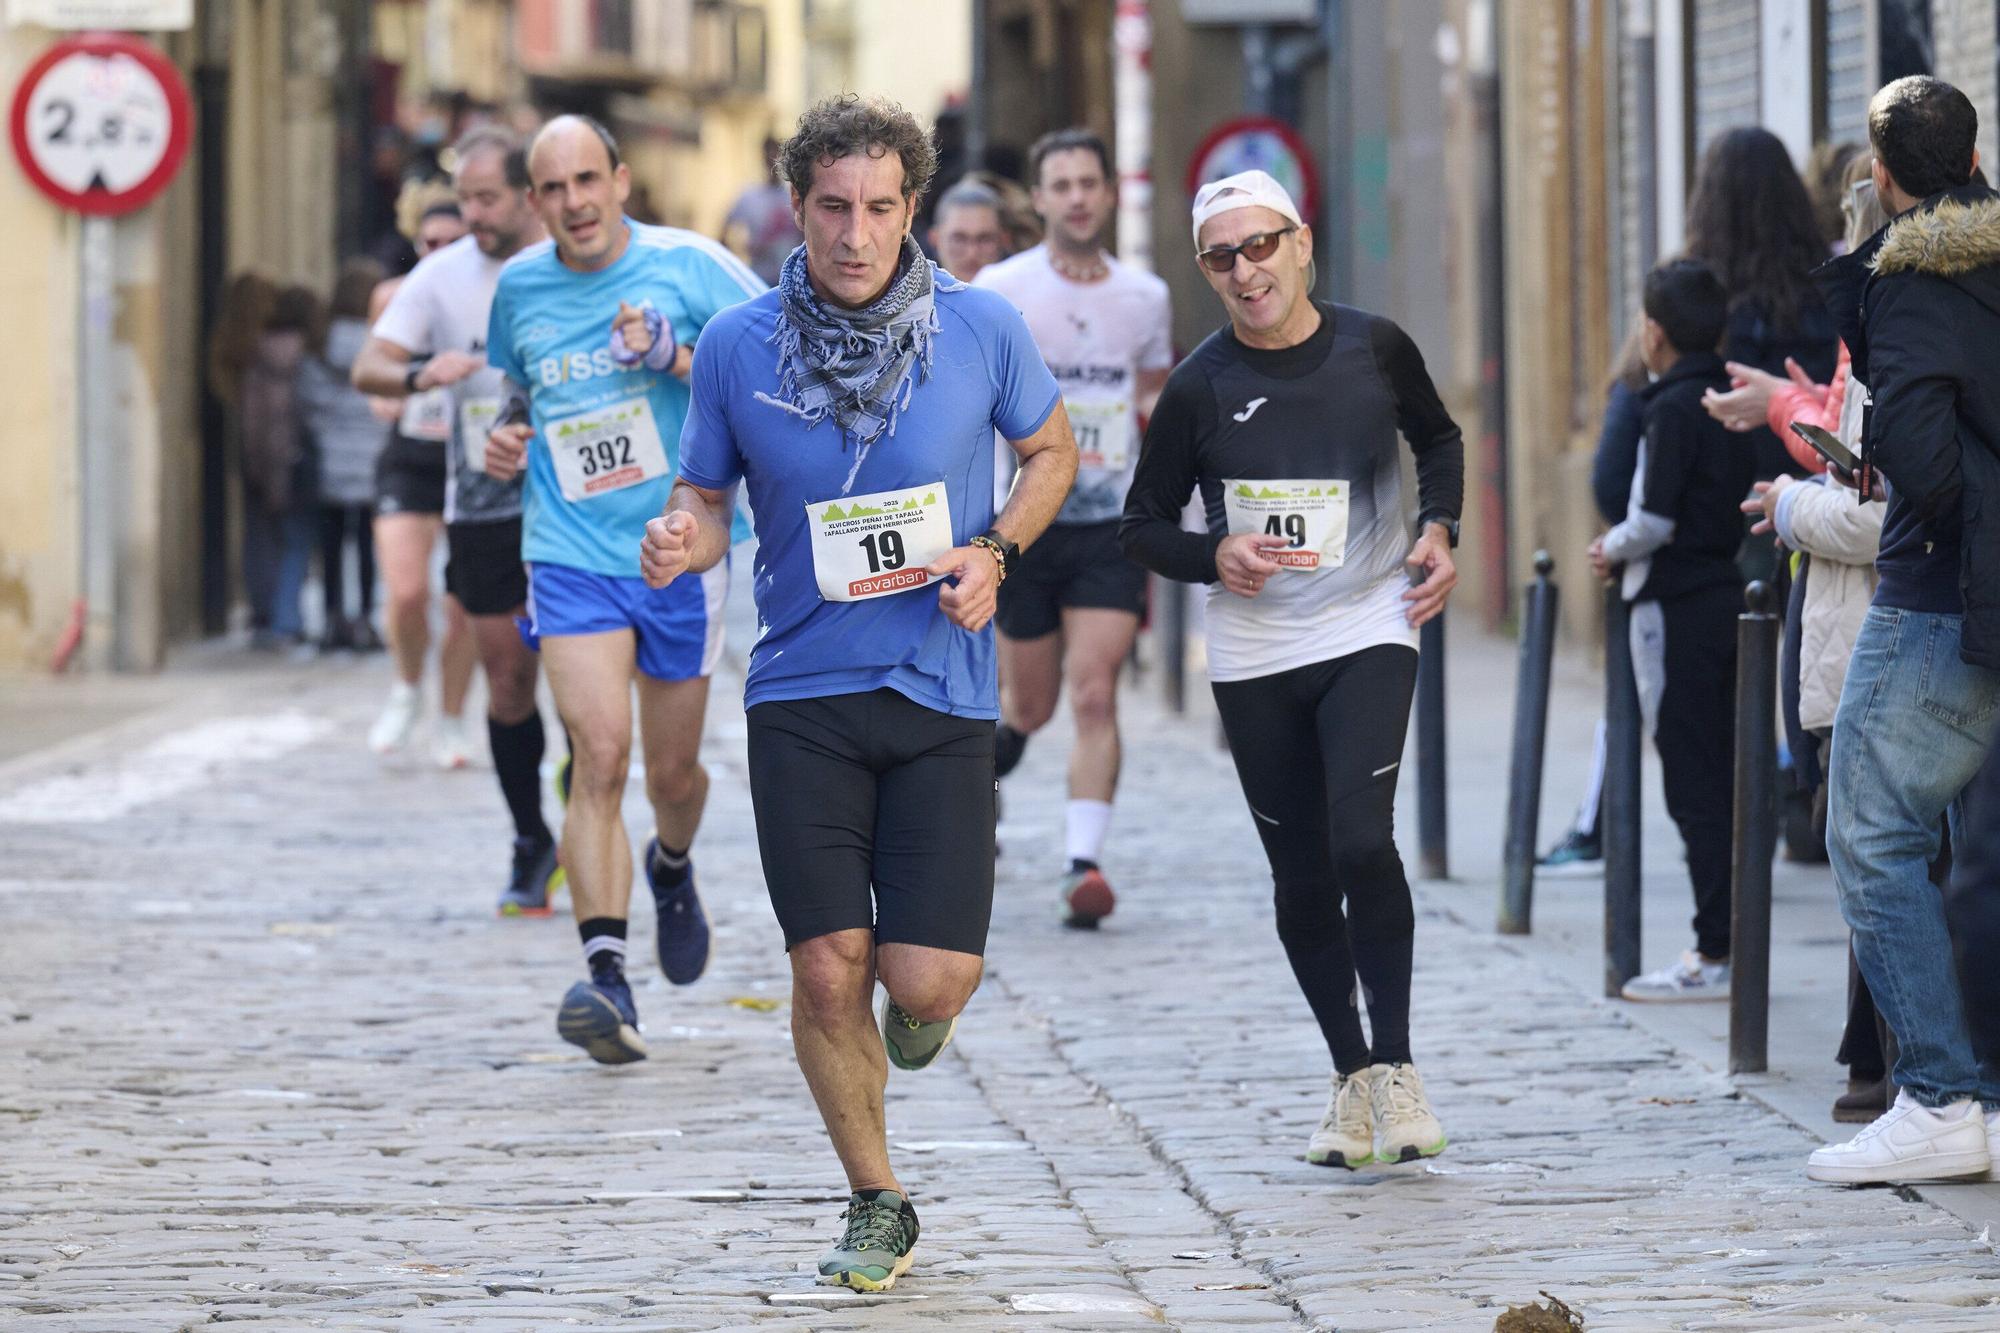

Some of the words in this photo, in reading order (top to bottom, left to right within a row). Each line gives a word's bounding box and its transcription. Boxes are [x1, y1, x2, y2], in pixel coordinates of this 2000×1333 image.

[578, 436, 635, 475] 392
[824, 526, 859, 537] TAFALLAKO
[860, 523, 882, 532] PEÑEN
[882, 520, 903, 528] HERRI
[903, 516, 924, 526] KROSA
[828, 521, 842, 529] XLVI
[842, 519, 860, 528] CROSS
[862, 515, 882, 524] PEÑAS
[895, 509, 923, 519] TAFALLA
[859, 530, 906, 573] 19
[853, 571, 924, 594] navarban
